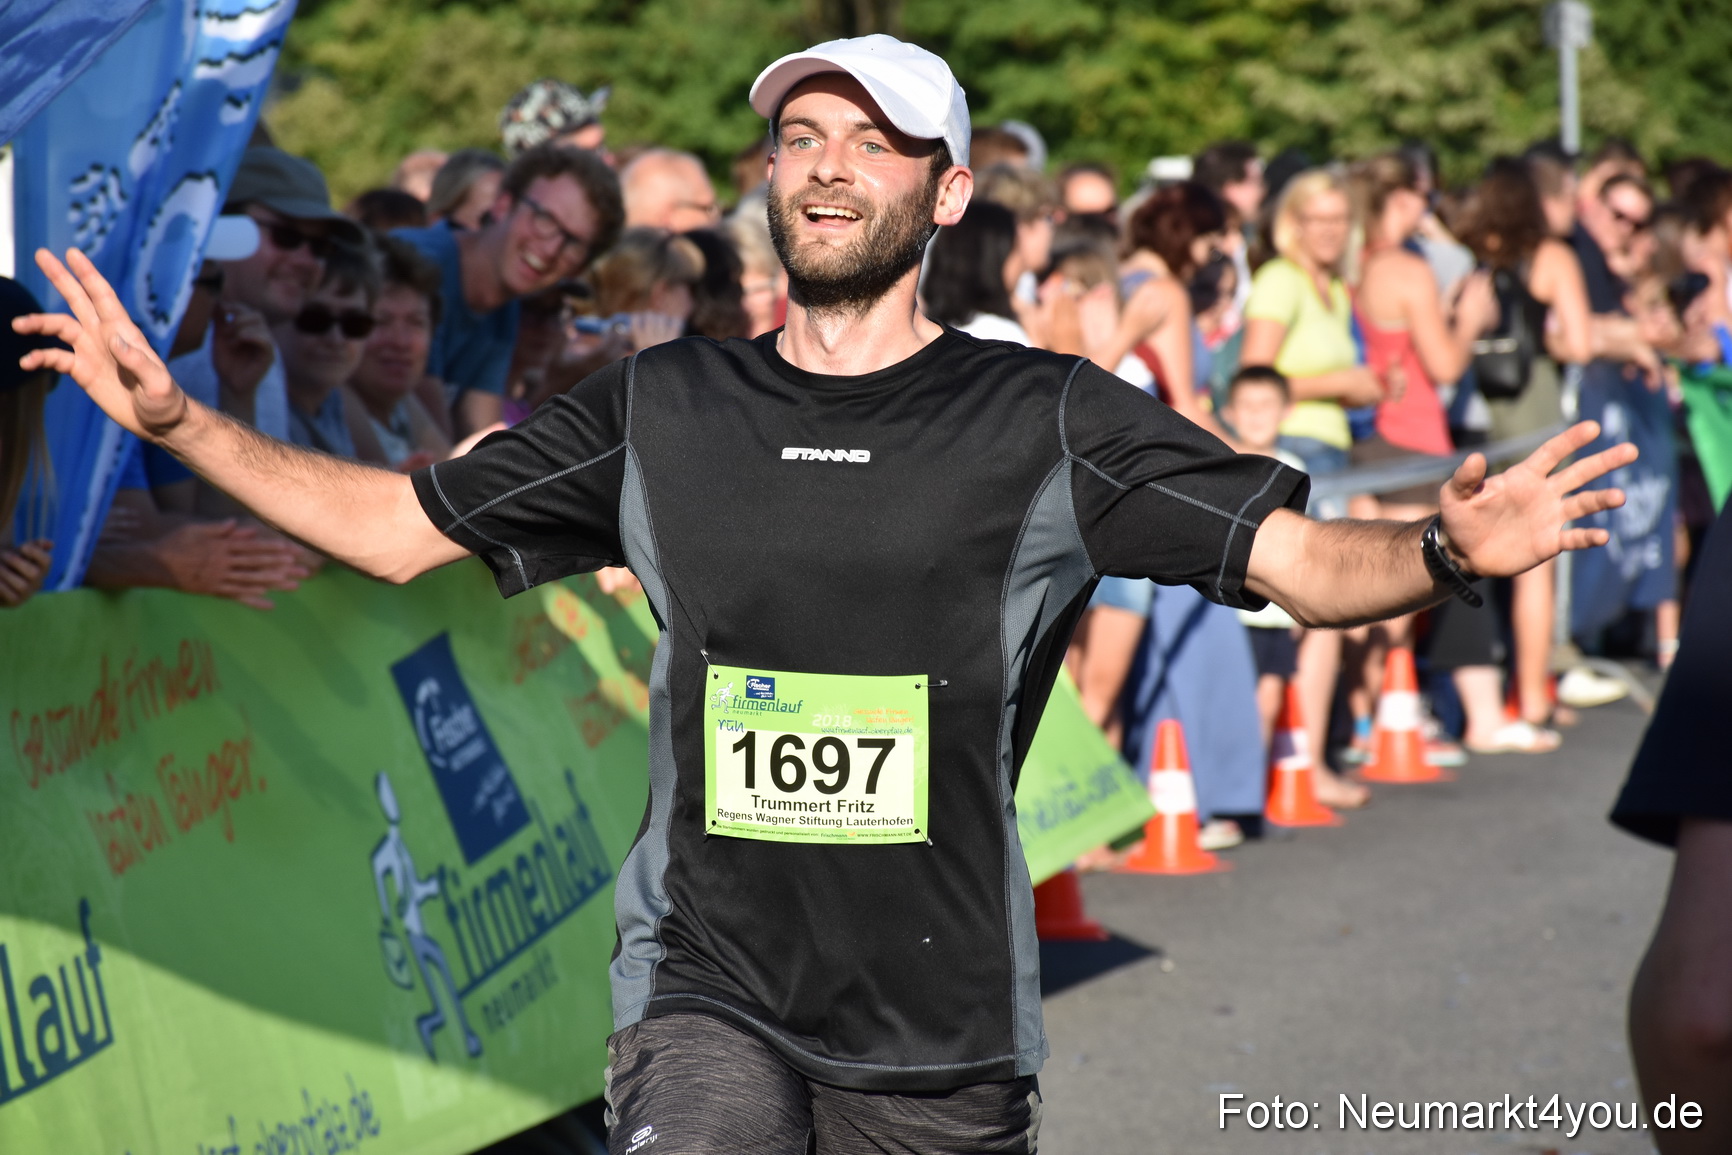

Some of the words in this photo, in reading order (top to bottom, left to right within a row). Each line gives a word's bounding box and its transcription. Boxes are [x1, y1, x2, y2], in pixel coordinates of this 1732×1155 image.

[781, 447, 871, 463] STANNO
[732, 695, 803, 713] firmenlauf
[811, 713, 853, 728] 2018
[732, 731, 896, 795] 1697
[751, 794, 831, 813] Trummert
[837, 799, 875, 813] Fritz
[717, 808, 753, 821] Regens
[756, 812, 796, 825] Wagner
[799, 815, 843, 828] Stiftung
[846, 816, 914, 826] Lauterhofen
[437, 766, 614, 992] firmenlauf
[0, 897, 114, 1106] lauf
